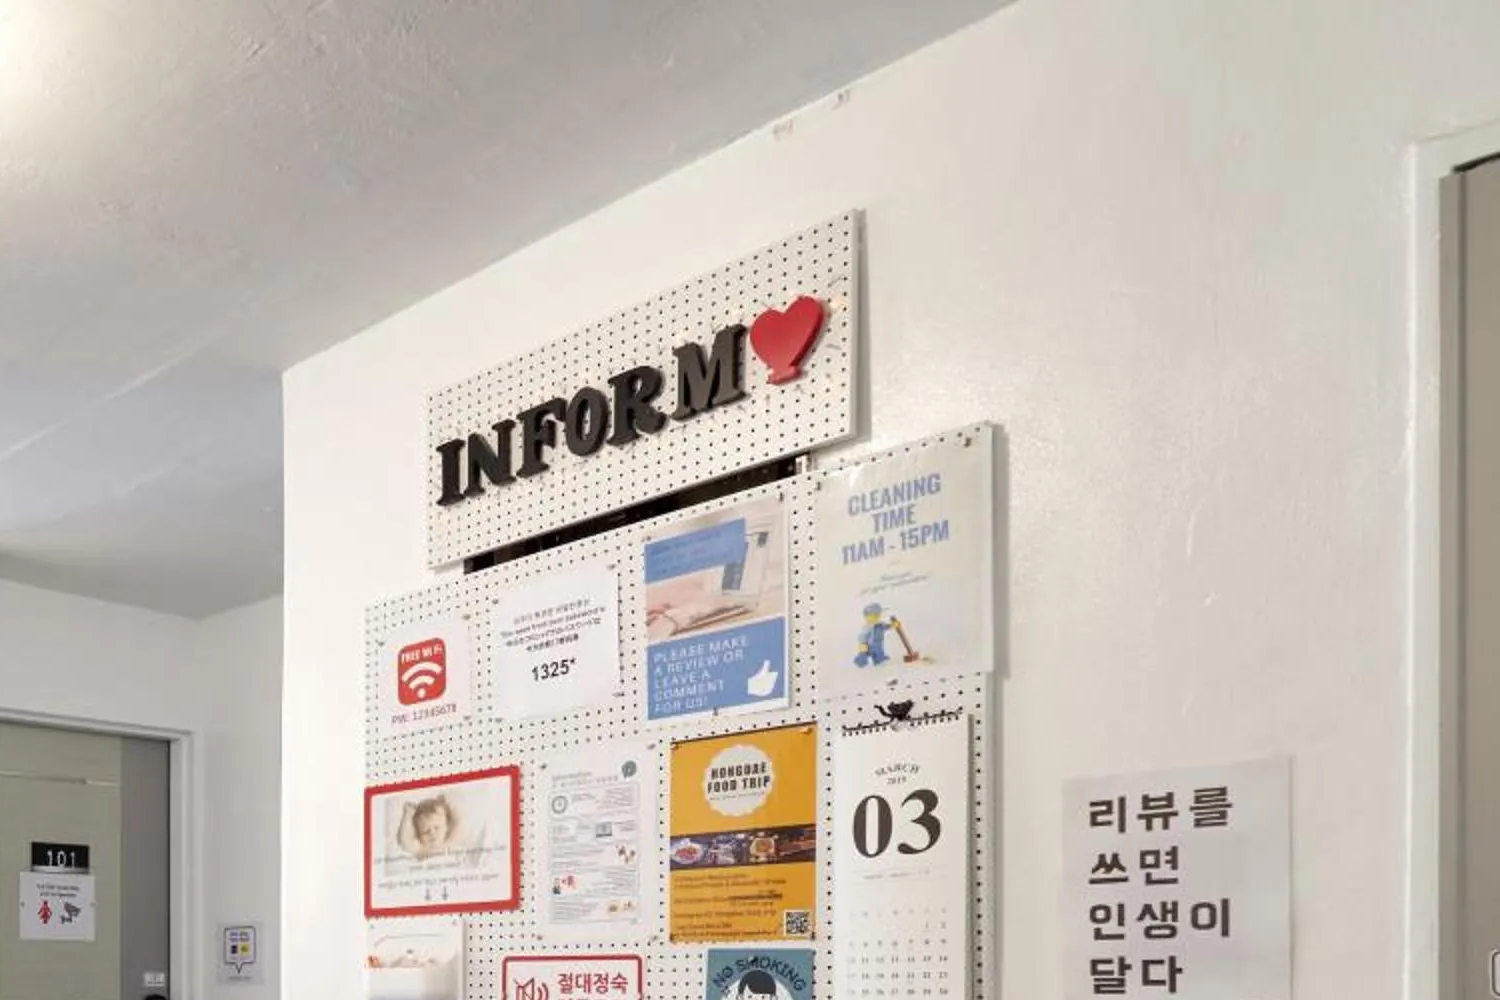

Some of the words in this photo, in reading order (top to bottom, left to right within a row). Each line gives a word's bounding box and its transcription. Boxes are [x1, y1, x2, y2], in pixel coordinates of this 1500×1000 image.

[436, 323, 747, 505] INFORM
[848, 473, 941, 516] CLEANING
[871, 503, 916, 533] TIME
[841, 536, 885, 565] 11AM
[900, 520, 949, 551] 15PM
[654, 645, 705, 664] PLEASE
[709, 636, 748, 653] MAKE
[667, 655, 720, 673] REVIEW
[655, 673, 698, 689] LEAVE
[655, 681, 725, 702] COMMENT
[707, 780, 738, 795] FOOD
[742, 774, 772, 790] TRIP
[852, 788, 942, 859] 03
[1088, 785, 1233, 834] 리뷰를
[46, 849, 76, 868] 101
[1088, 845, 1180, 886] 쓰면
[1088, 898, 1231, 942] 인생이
[557, 972, 629, 995] 절대정숙
[711, 965, 734, 989] NO
[735, 955, 807, 992] SMOKING
[1089, 955, 1183, 995] 달다
